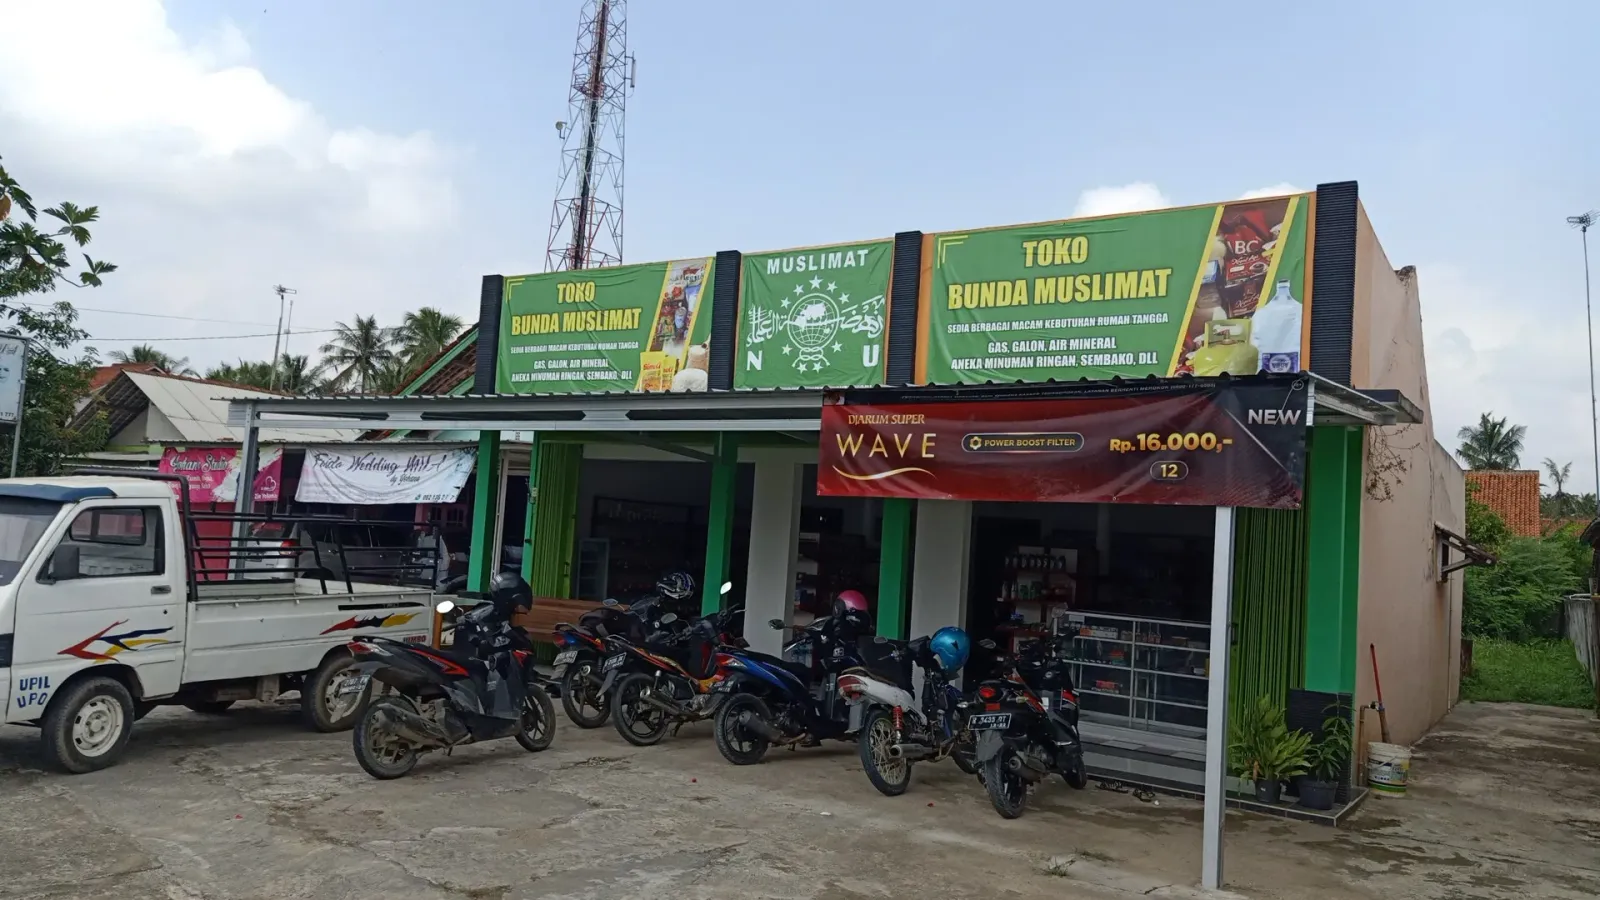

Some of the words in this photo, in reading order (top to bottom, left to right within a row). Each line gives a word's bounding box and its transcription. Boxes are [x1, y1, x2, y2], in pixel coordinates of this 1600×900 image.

[1022, 236, 1089, 267] TOKO
[767, 249, 869, 275] MUSLIMAT
[557, 281, 596, 304] TOKO
[948, 279, 1028, 310] BUNDA
[1033, 268, 1172, 305] MUSLIMAT
[511, 312, 560, 336] BUNDA
[562, 308, 642, 333] MUSLIMAT
[947, 324, 970, 334] SEDIA
[970, 322, 1010, 333] BERBAGAI
[1011, 320, 1044, 331] MACAM
[1044, 317, 1096, 329] KEBUTUHAN
[1097, 315, 1130, 327] RUMAH
[1132, 313, 1169, 325] TANGGA
[548, 344, 568, 352] MACAM
[618, 341, 639, 349] TANGGA
[988, 341, 1010, 354] GAS,
[1012, 340, 1047, 353] GALON,
[1049, 338, 1068, 351] AIR
[1069, 336, 1117, 350] MINERAL
[533, 360, 546, 370] GAS,
[547, 360, 569, 369] GALON,
[569, 359, 581, 368] AIR
[581, 359, 609, 368] MINERAL
[746, 350, 763, 371] N
[862, 344, 880, 367] U
[951, 358, 984, 370] ANEKA
[984, 356, 1034, 369] MINUMAN
[1036, 355, 1079, 368] RINGAN,
[1080, 353, 1137, 366] SEMBAKO,
[1138, 352, 1158, 365] DLL
[511, 372, 530, 382] ANEKA
[530, 372, 560, 381] MINUMAN
[621, 370, 633, 380] DLL
[848, 414, 889, 426] DJARUM
[891, 413, 925, 425] SUPER
[1247, 409, 1302, 425] NEW
[836, 433, 937, 458] WAVE
[984, 439, 1015, 447] POWER
[1047, 438, 1076, 446] FILTER
[1109, 438, 1136, 453] Rp.
[1136, 432, 1233, 453] 16.000,-
[347, 452, 401, 477] Wedding
[1160, 463, 1178, 478] 12
[19, 675, 51, 691] UPIL
[16, 692, 48, 709] UPO
